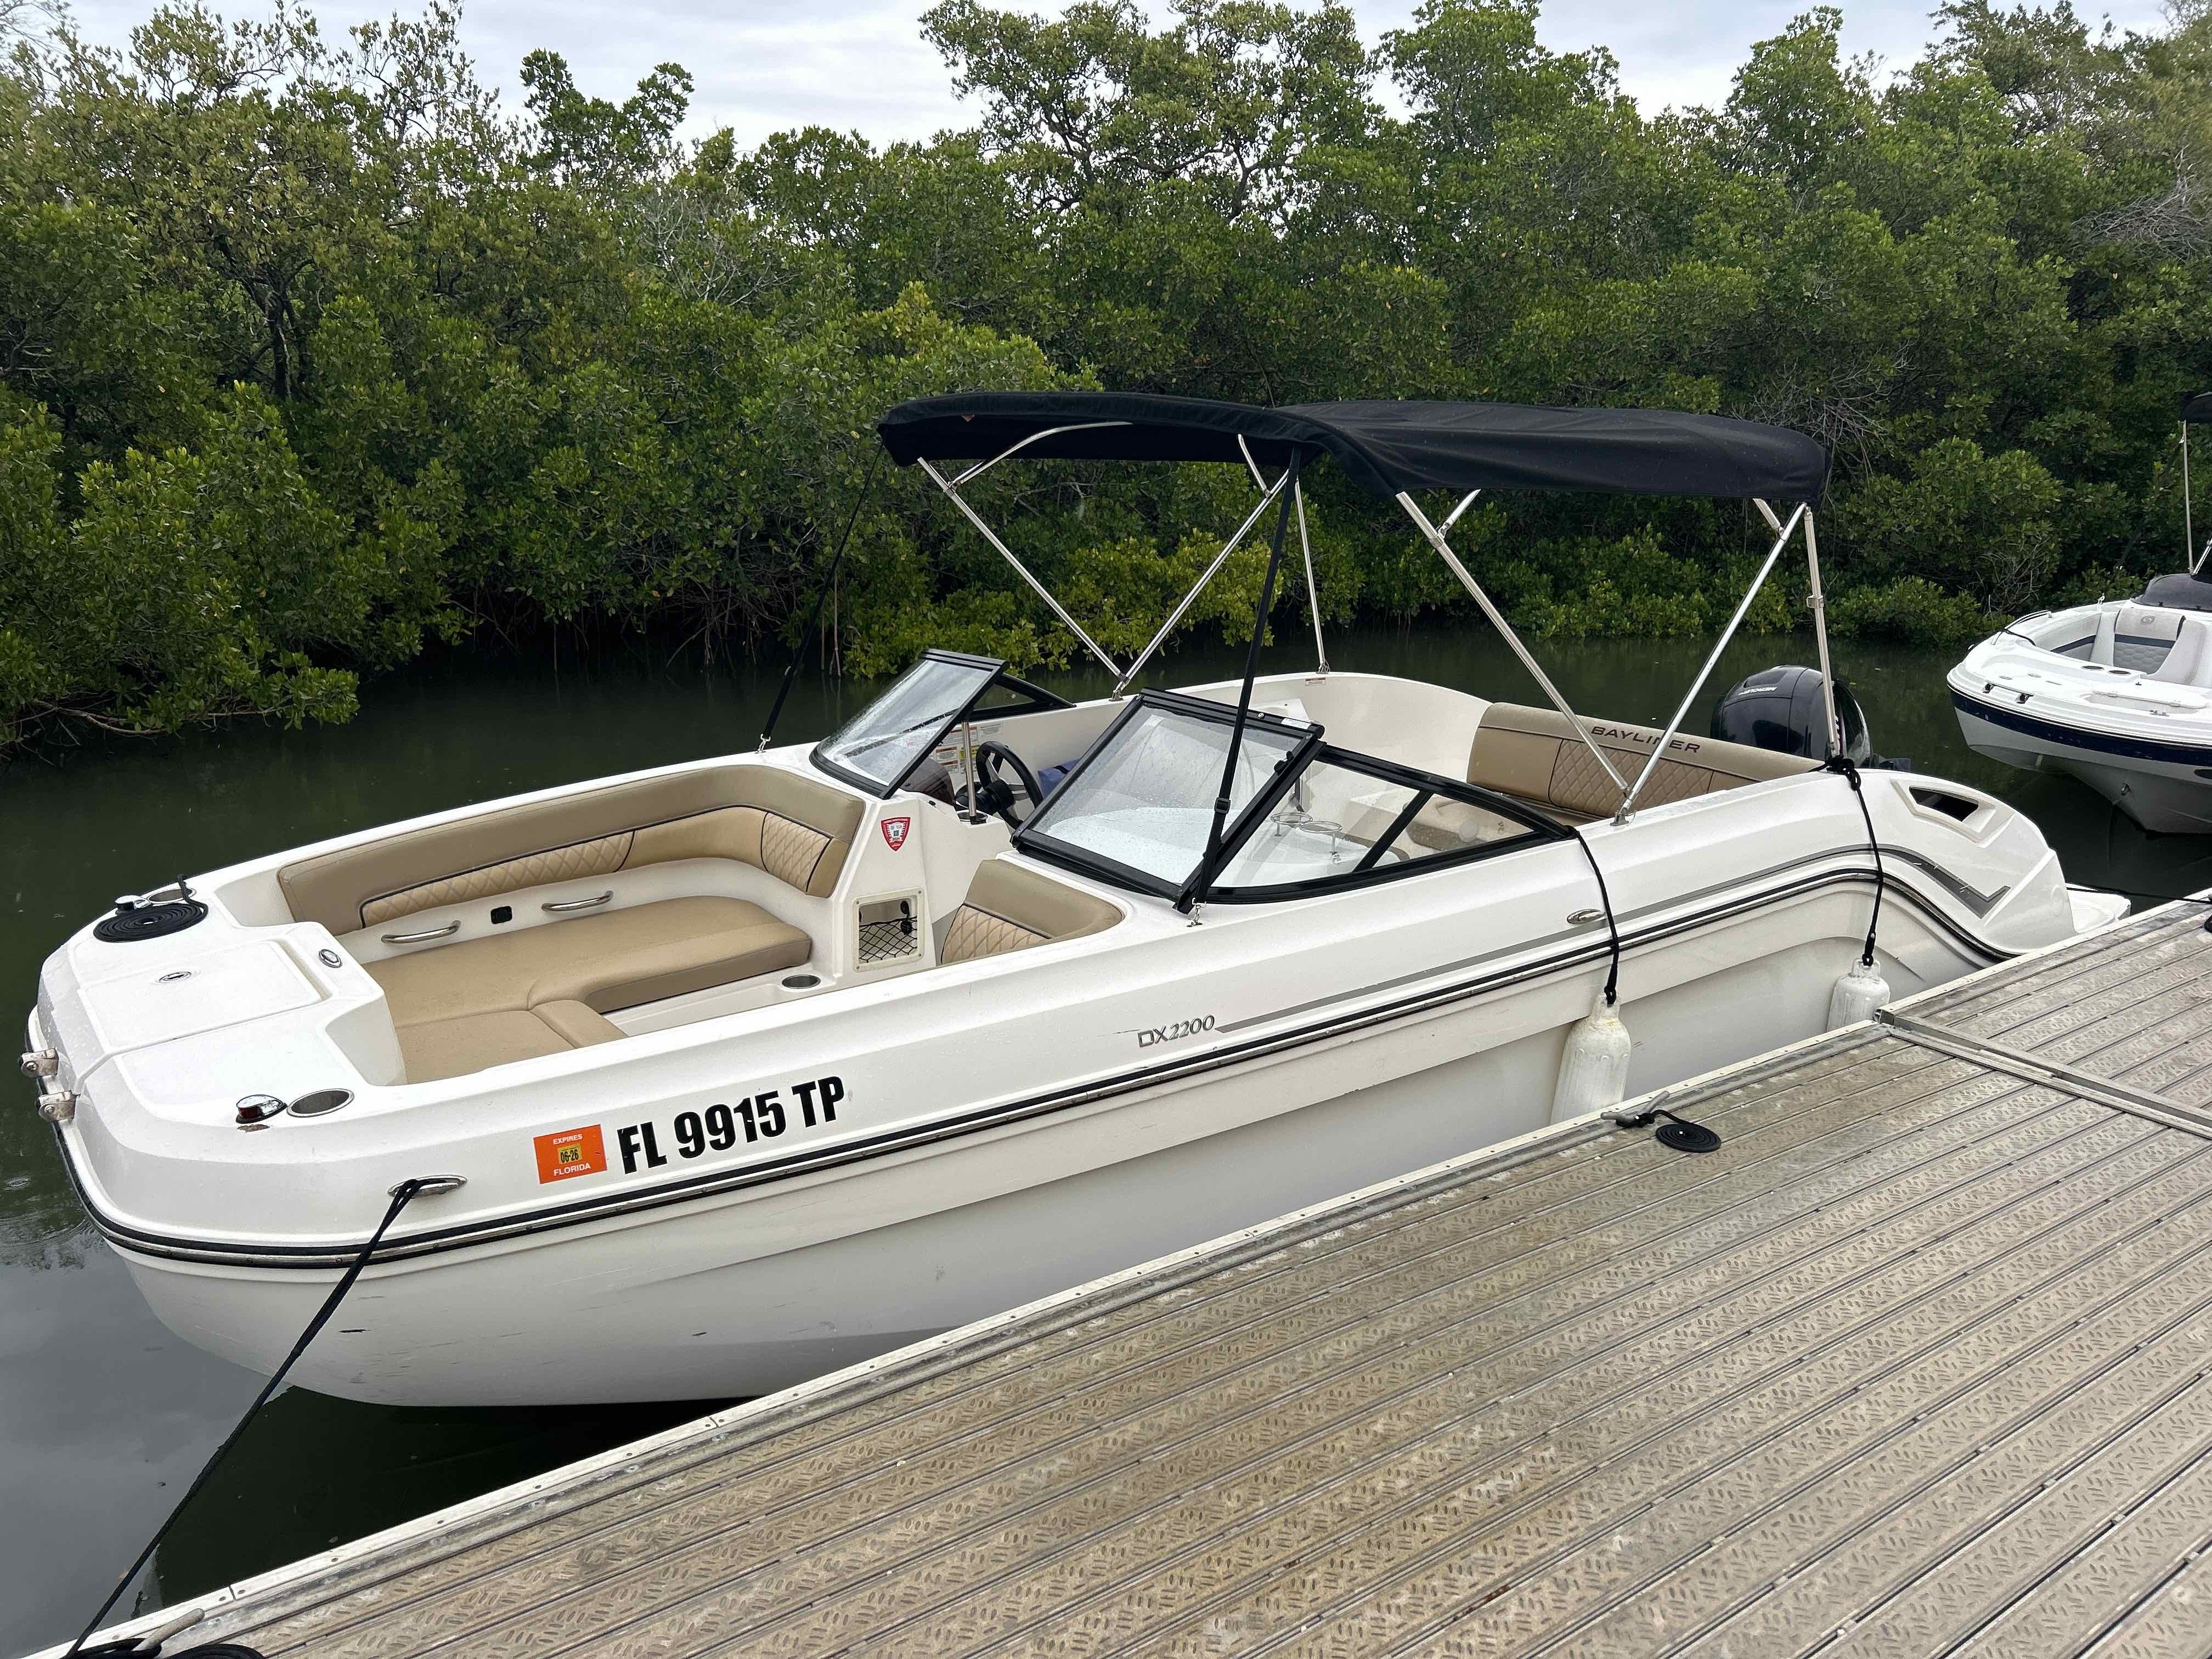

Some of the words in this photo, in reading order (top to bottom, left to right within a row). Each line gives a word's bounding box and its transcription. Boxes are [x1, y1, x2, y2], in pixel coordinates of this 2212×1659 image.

[1138, 1014, 1215, 1047] DX2200
[617, 1121, 668, 1175] FL
[674, 1090, 786, 1159] 9915
[791, 1076, 844, 1128] TP
[553, 1133, 583, 1145] EXPIRES
[560, 1149, 579, 1163] 06-26
[554, 1163, 591, 1176] FLORIDA
